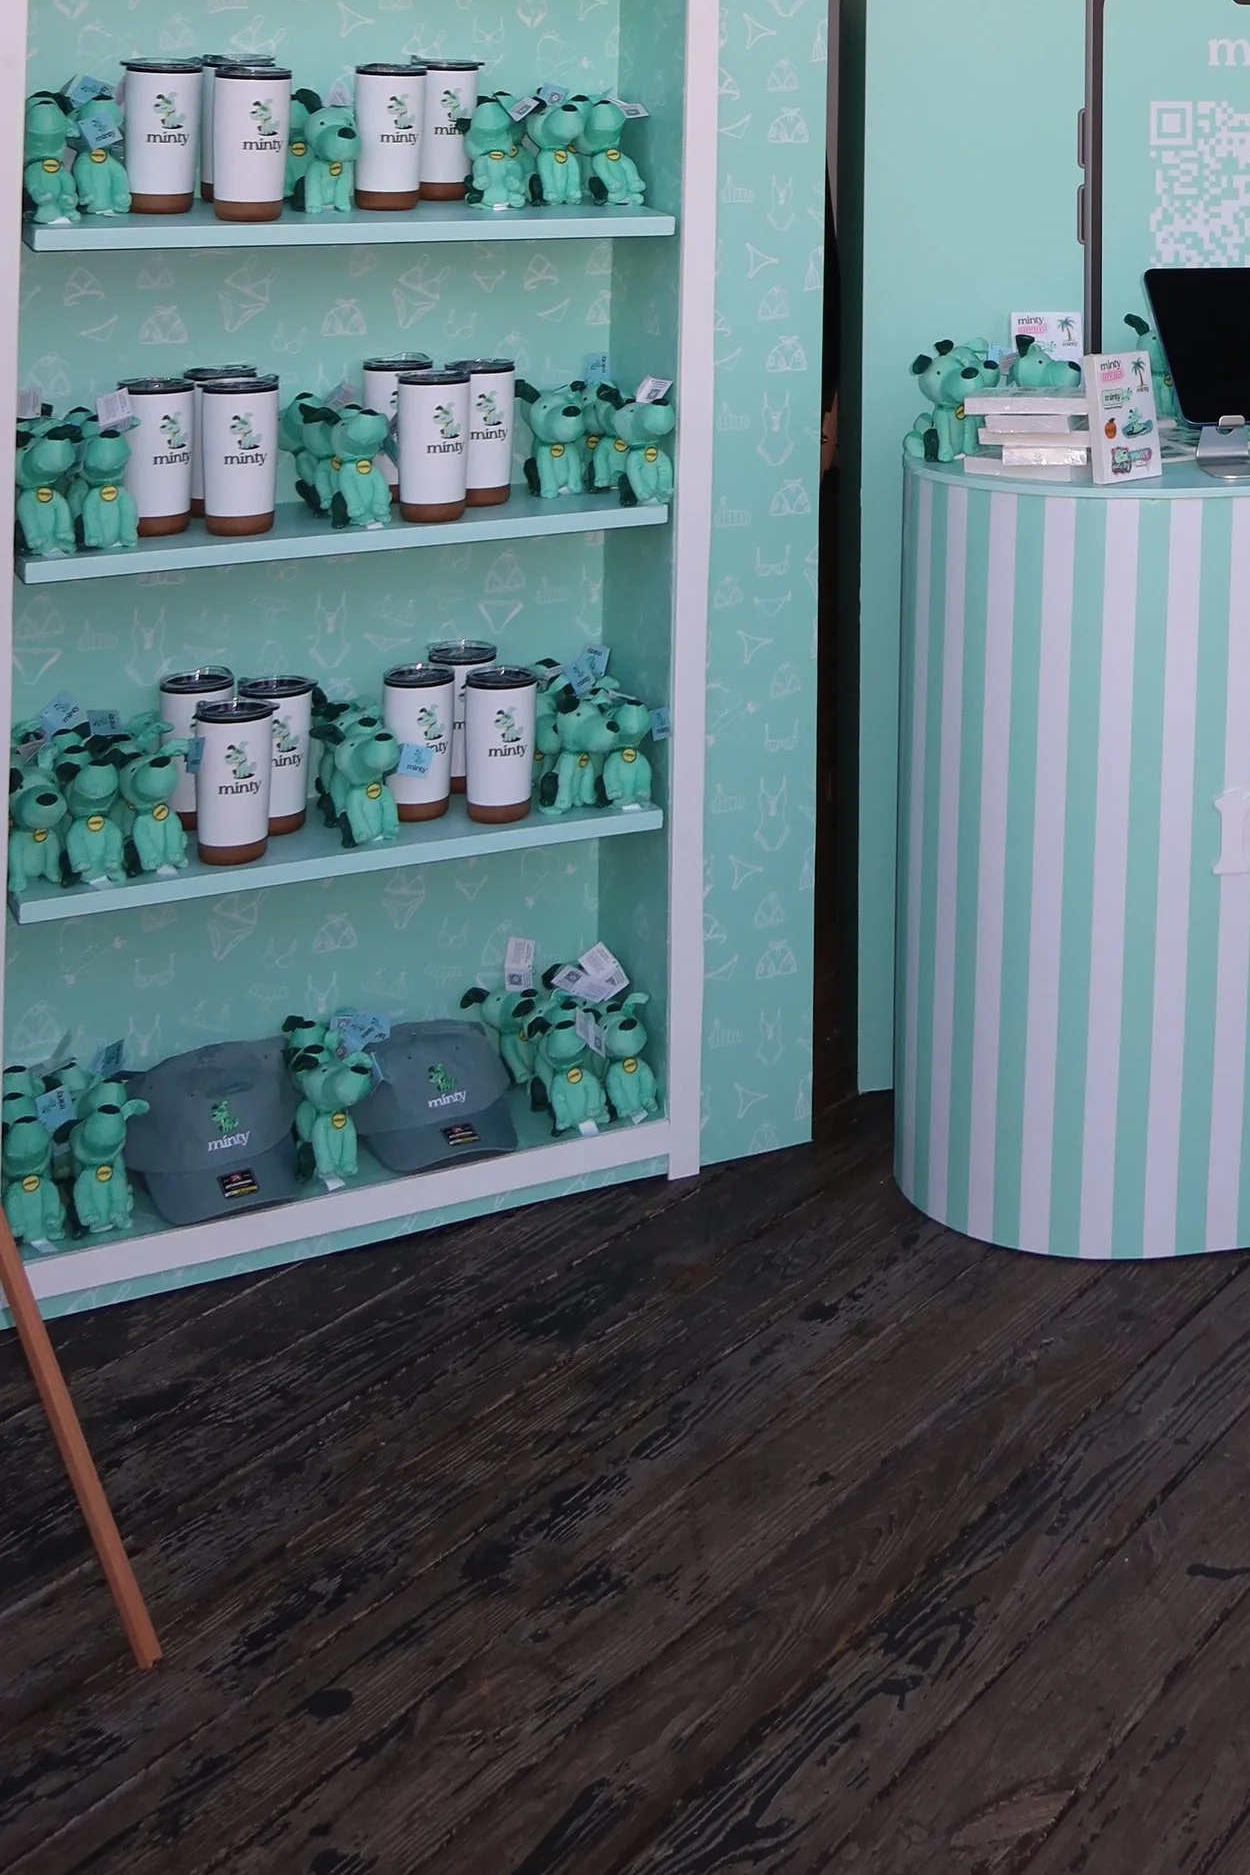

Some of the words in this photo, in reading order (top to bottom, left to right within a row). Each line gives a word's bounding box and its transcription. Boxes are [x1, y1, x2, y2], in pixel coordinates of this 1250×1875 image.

[147, 131, 189, 146] minty
[243, 138, 284, 153] minty
[381, 131, 419, 146] minty
[1018, 315, 1044, 326] minty
[470, 428, 508, 442] minty
[427, 441, 465, 454] minty
[153, 452, 191, 465] minty
[224, 452, 268, 466] minty
[488, 745, 527, 757] minty
[217, 780, 262, 796] minty
[428, 1090, 466, 1108] minty
[207, 1131, 251, 1153] minty
